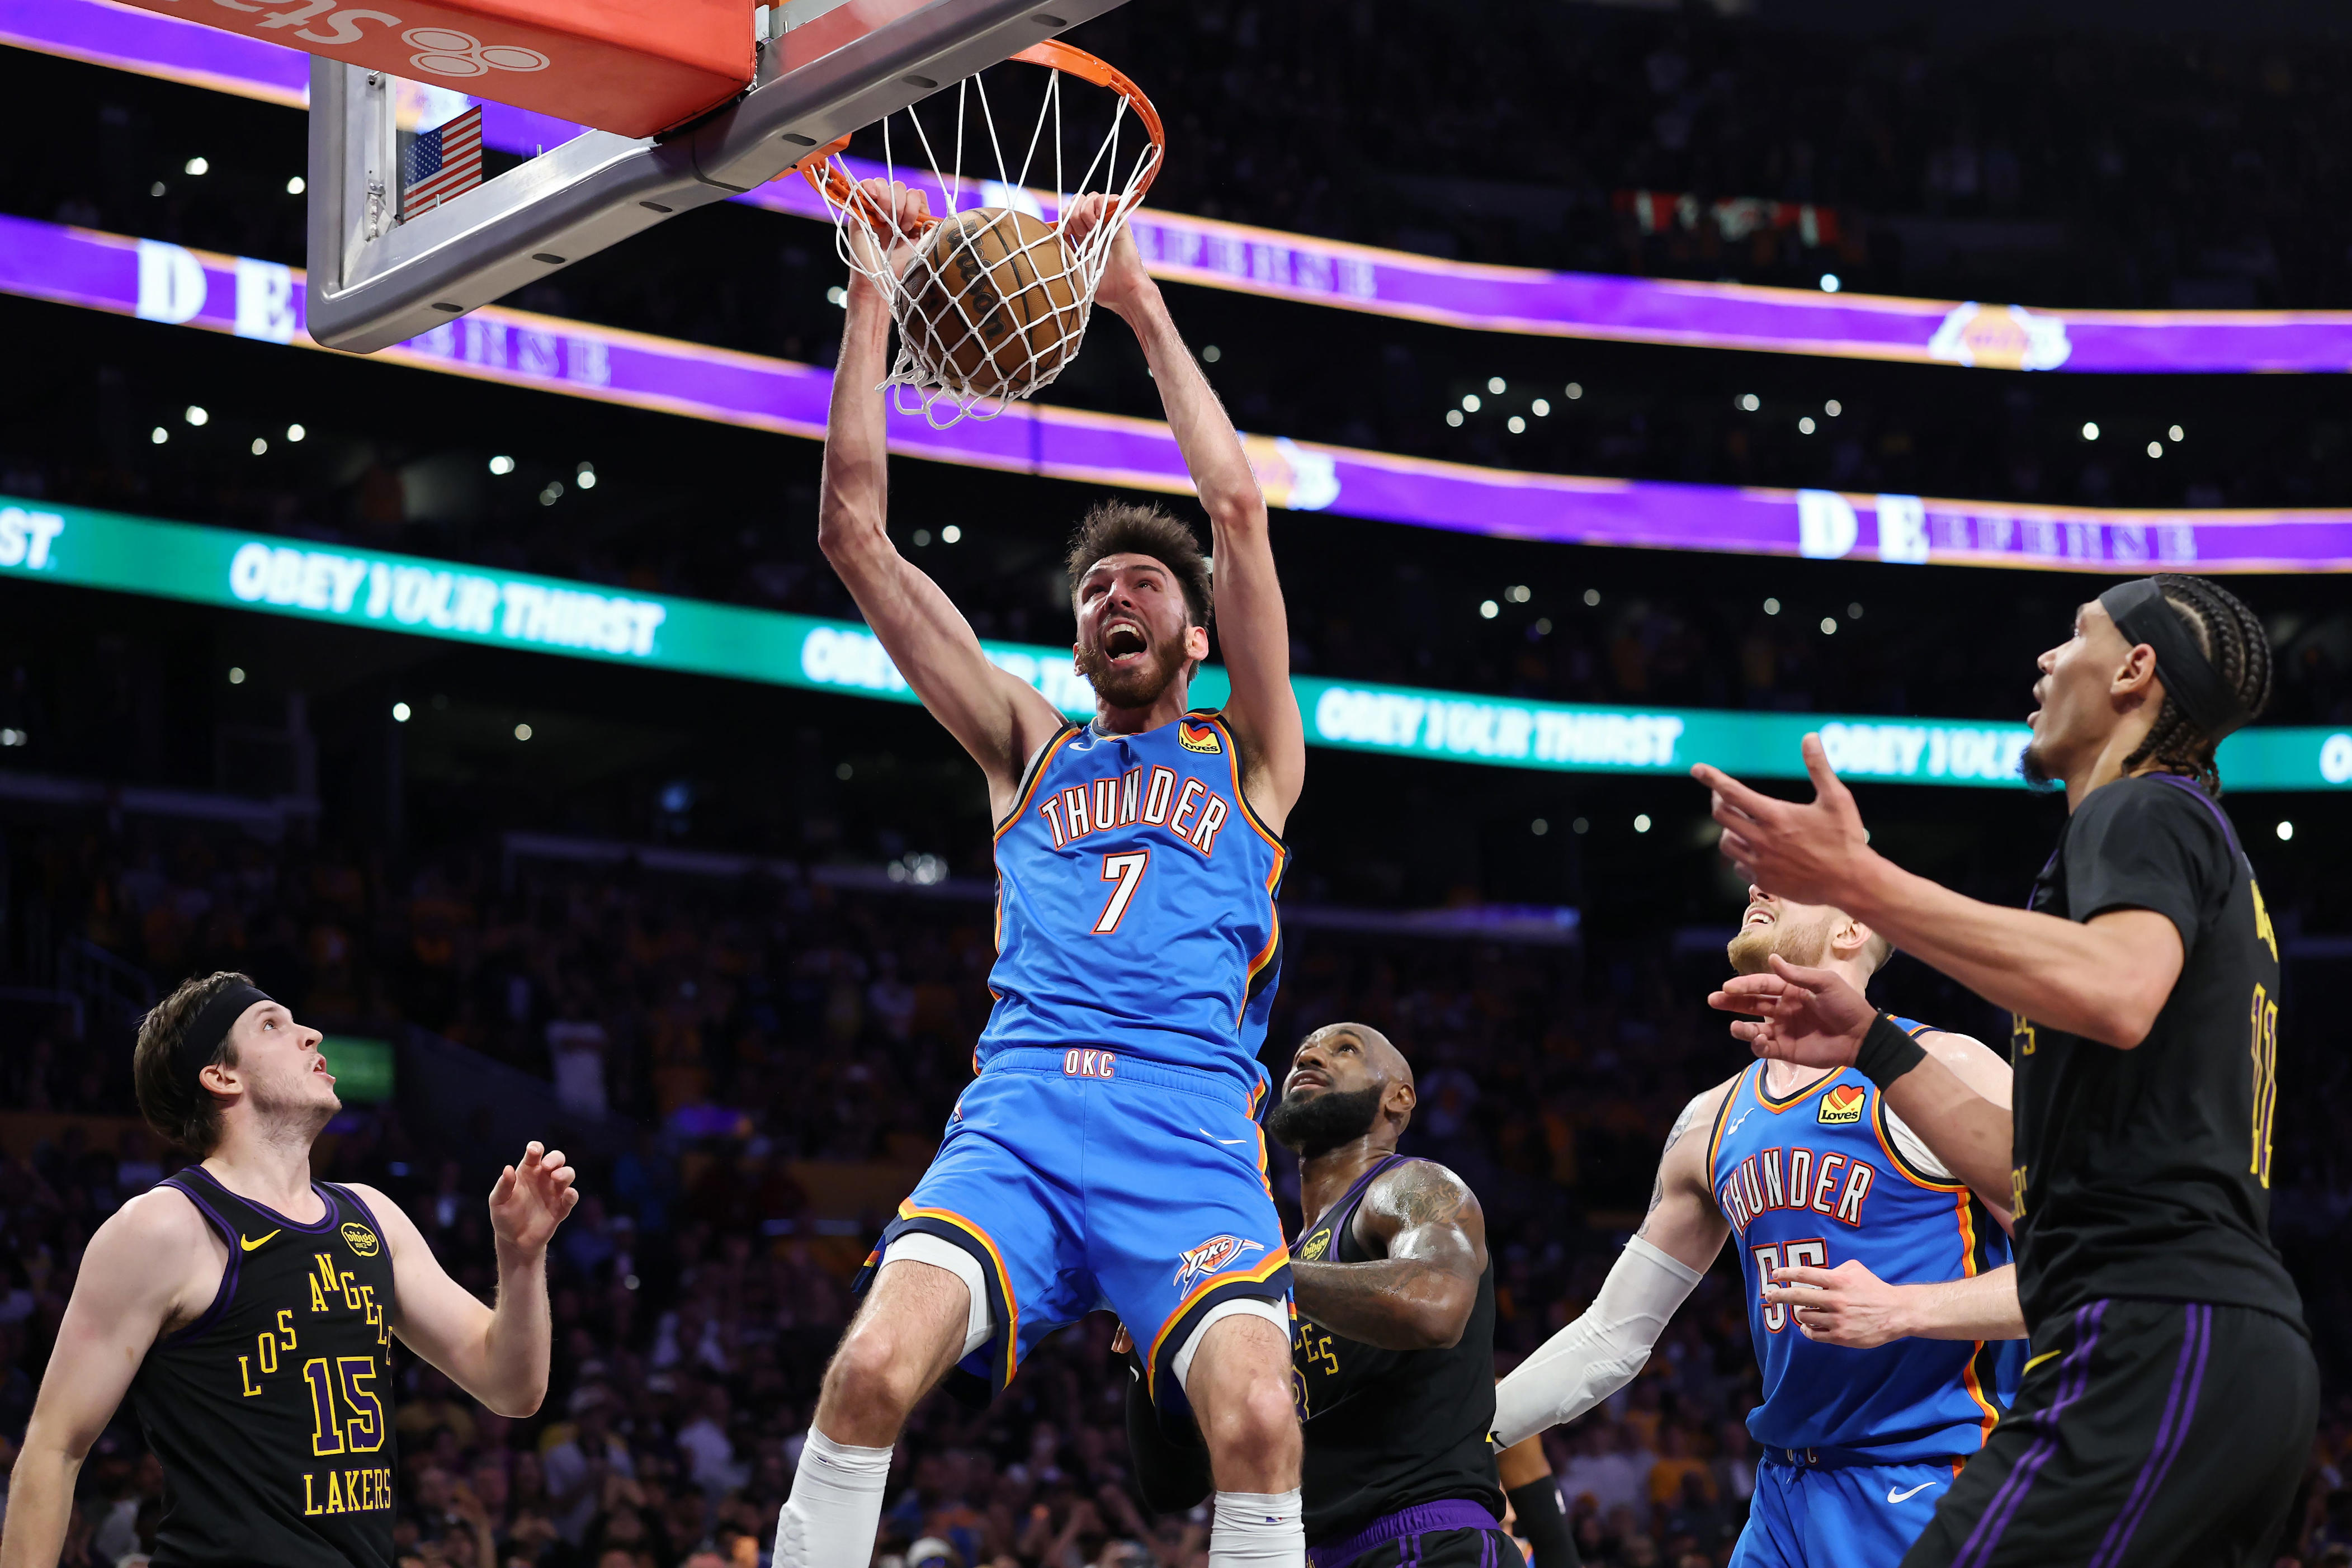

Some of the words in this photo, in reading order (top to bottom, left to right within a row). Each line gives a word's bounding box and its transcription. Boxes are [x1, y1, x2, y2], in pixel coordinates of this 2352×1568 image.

[230, 542, 366, 613] OBEY
[501, 581, 666, 657] THIRST
[1315, 687, 1427, 748] OBEY
[1533, 710, 1684, 767] THIRST
[1819, 722, 1926, 776] OBEY
[1038, 764, 1230, 858] THUNDER
[1089, 849, 1150, 935] 7
[1064, 1048, 1116, 1079] OKC
[1722, 1146, 1876, 1240] THUNDER
[344, 1230, 375, 1246] bibigo
[1186, 1239, 1231, 1282] OKC
[1304, 1238, 1329, 1257] bibigo
[237, 1309, 297, 1397] LOS
[303, 1356, 385, 1456] 15
[303, 1468, 391, 1516] LAKERS
